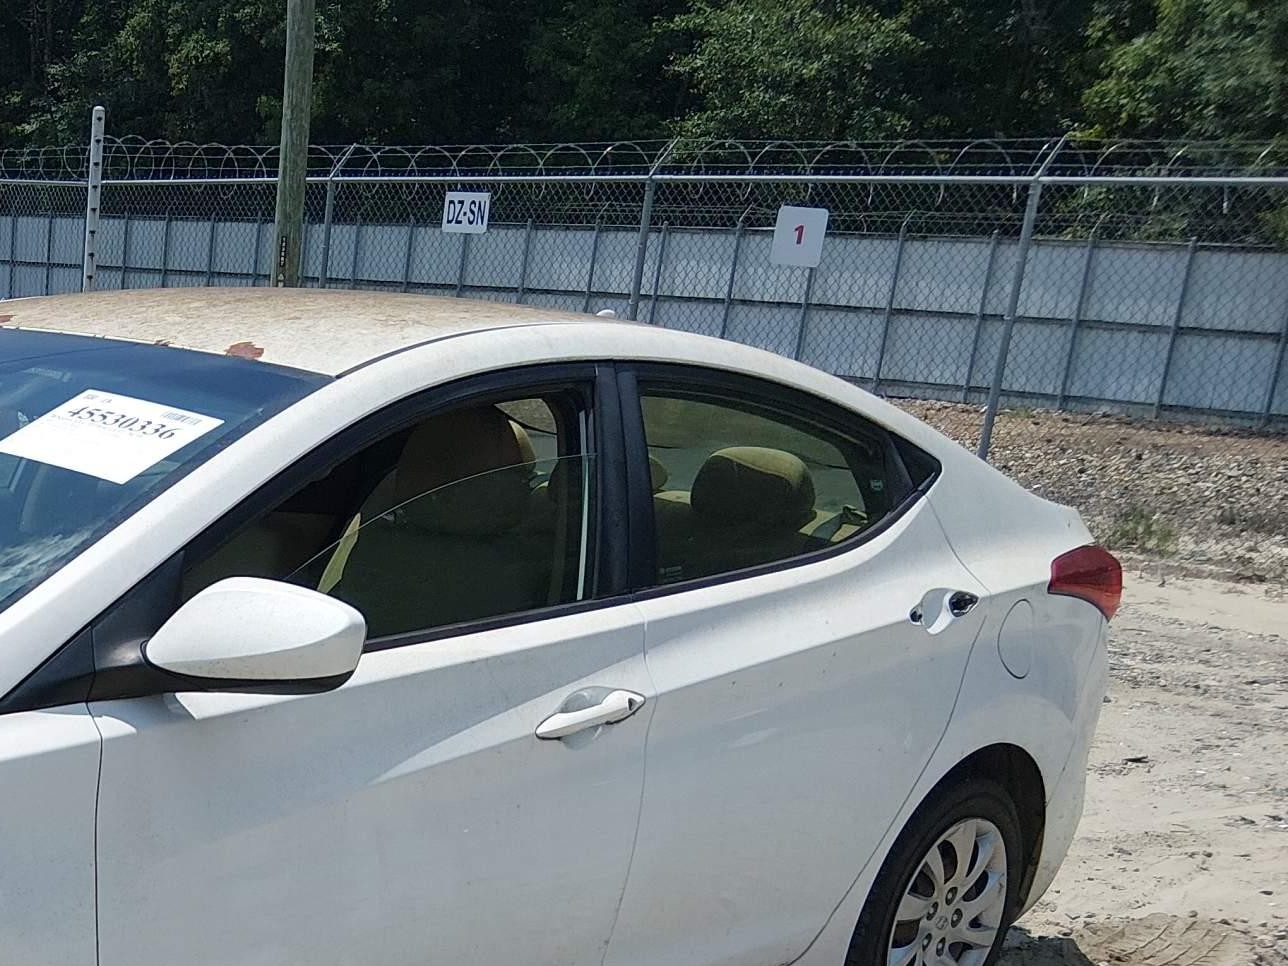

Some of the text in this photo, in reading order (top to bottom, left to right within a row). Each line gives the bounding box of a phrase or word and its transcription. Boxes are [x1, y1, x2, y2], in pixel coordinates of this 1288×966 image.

[446, 199, 487, 226] DZ-SN
[794, 224, 805, 245] 1
[68, 406, 184, 440] 45530336
